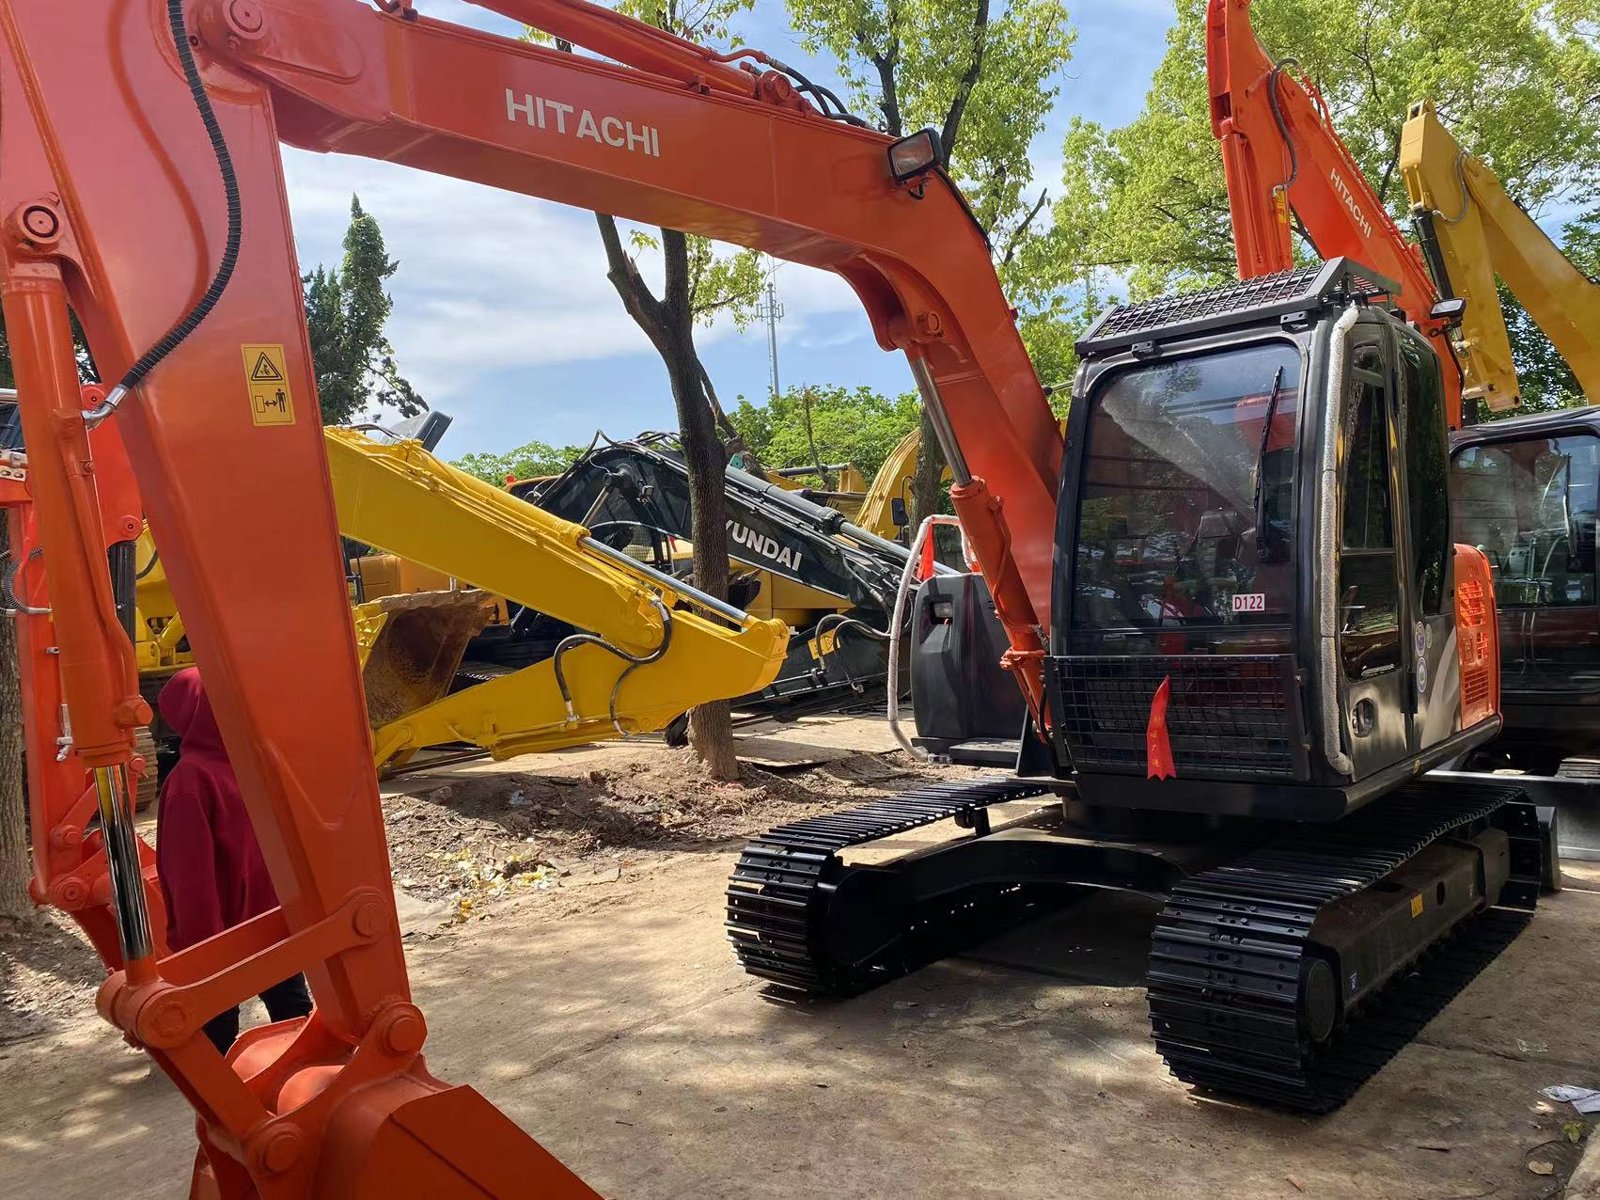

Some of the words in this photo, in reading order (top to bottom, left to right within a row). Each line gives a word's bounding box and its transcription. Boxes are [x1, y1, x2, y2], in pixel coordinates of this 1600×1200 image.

[505, 88, 660, 158] HITACHI
[1330, 168, 1372, 239] HITACHI
[1234, 595, 1263, 610] D122
